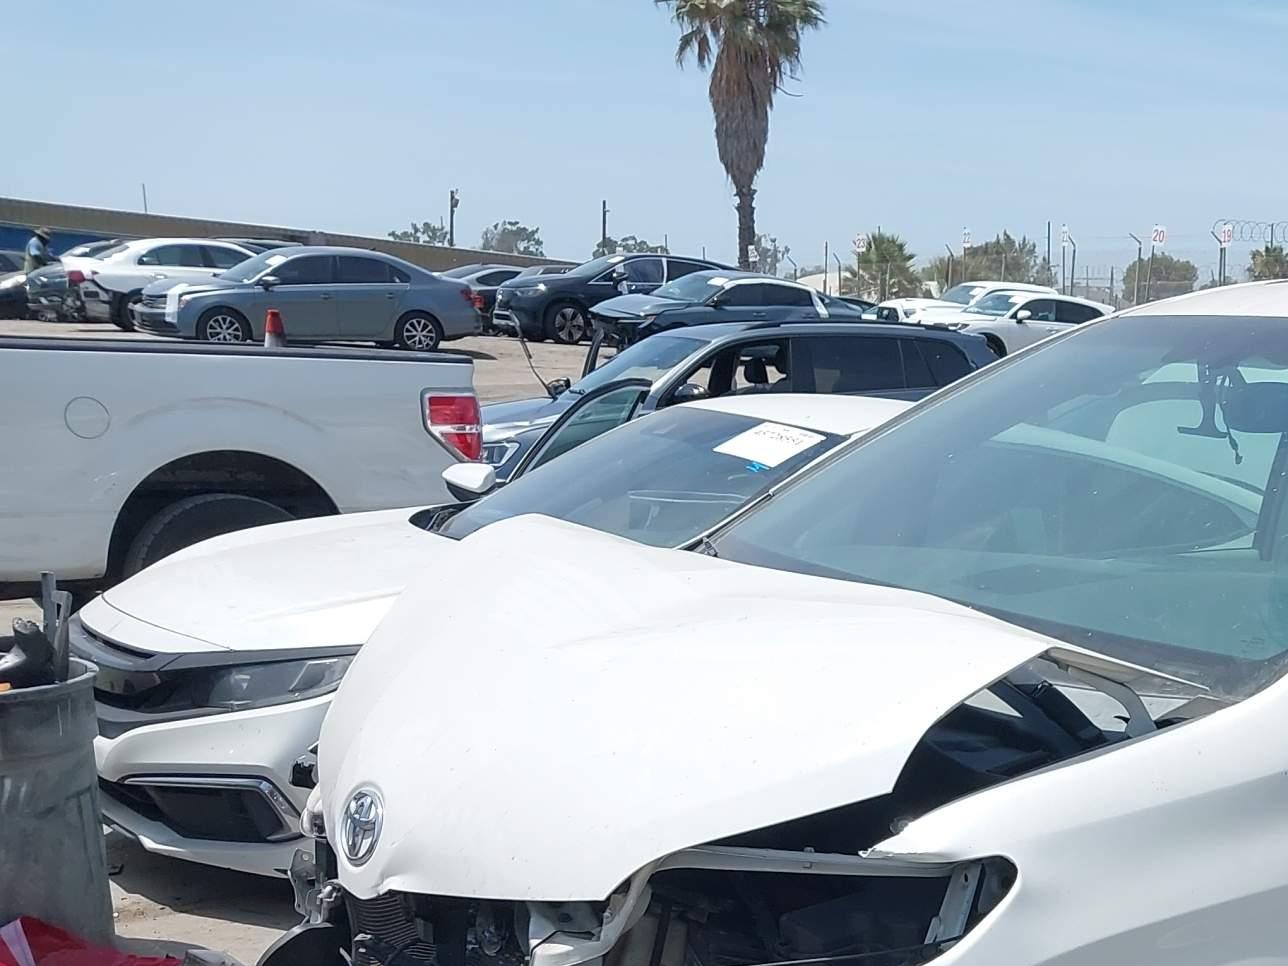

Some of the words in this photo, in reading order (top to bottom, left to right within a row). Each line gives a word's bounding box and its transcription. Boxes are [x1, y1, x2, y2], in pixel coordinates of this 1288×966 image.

[1152, 229, 1165, 243] 20
[1222, 229, 1232, 243] 19
[856, 238, 866, 249] 23
